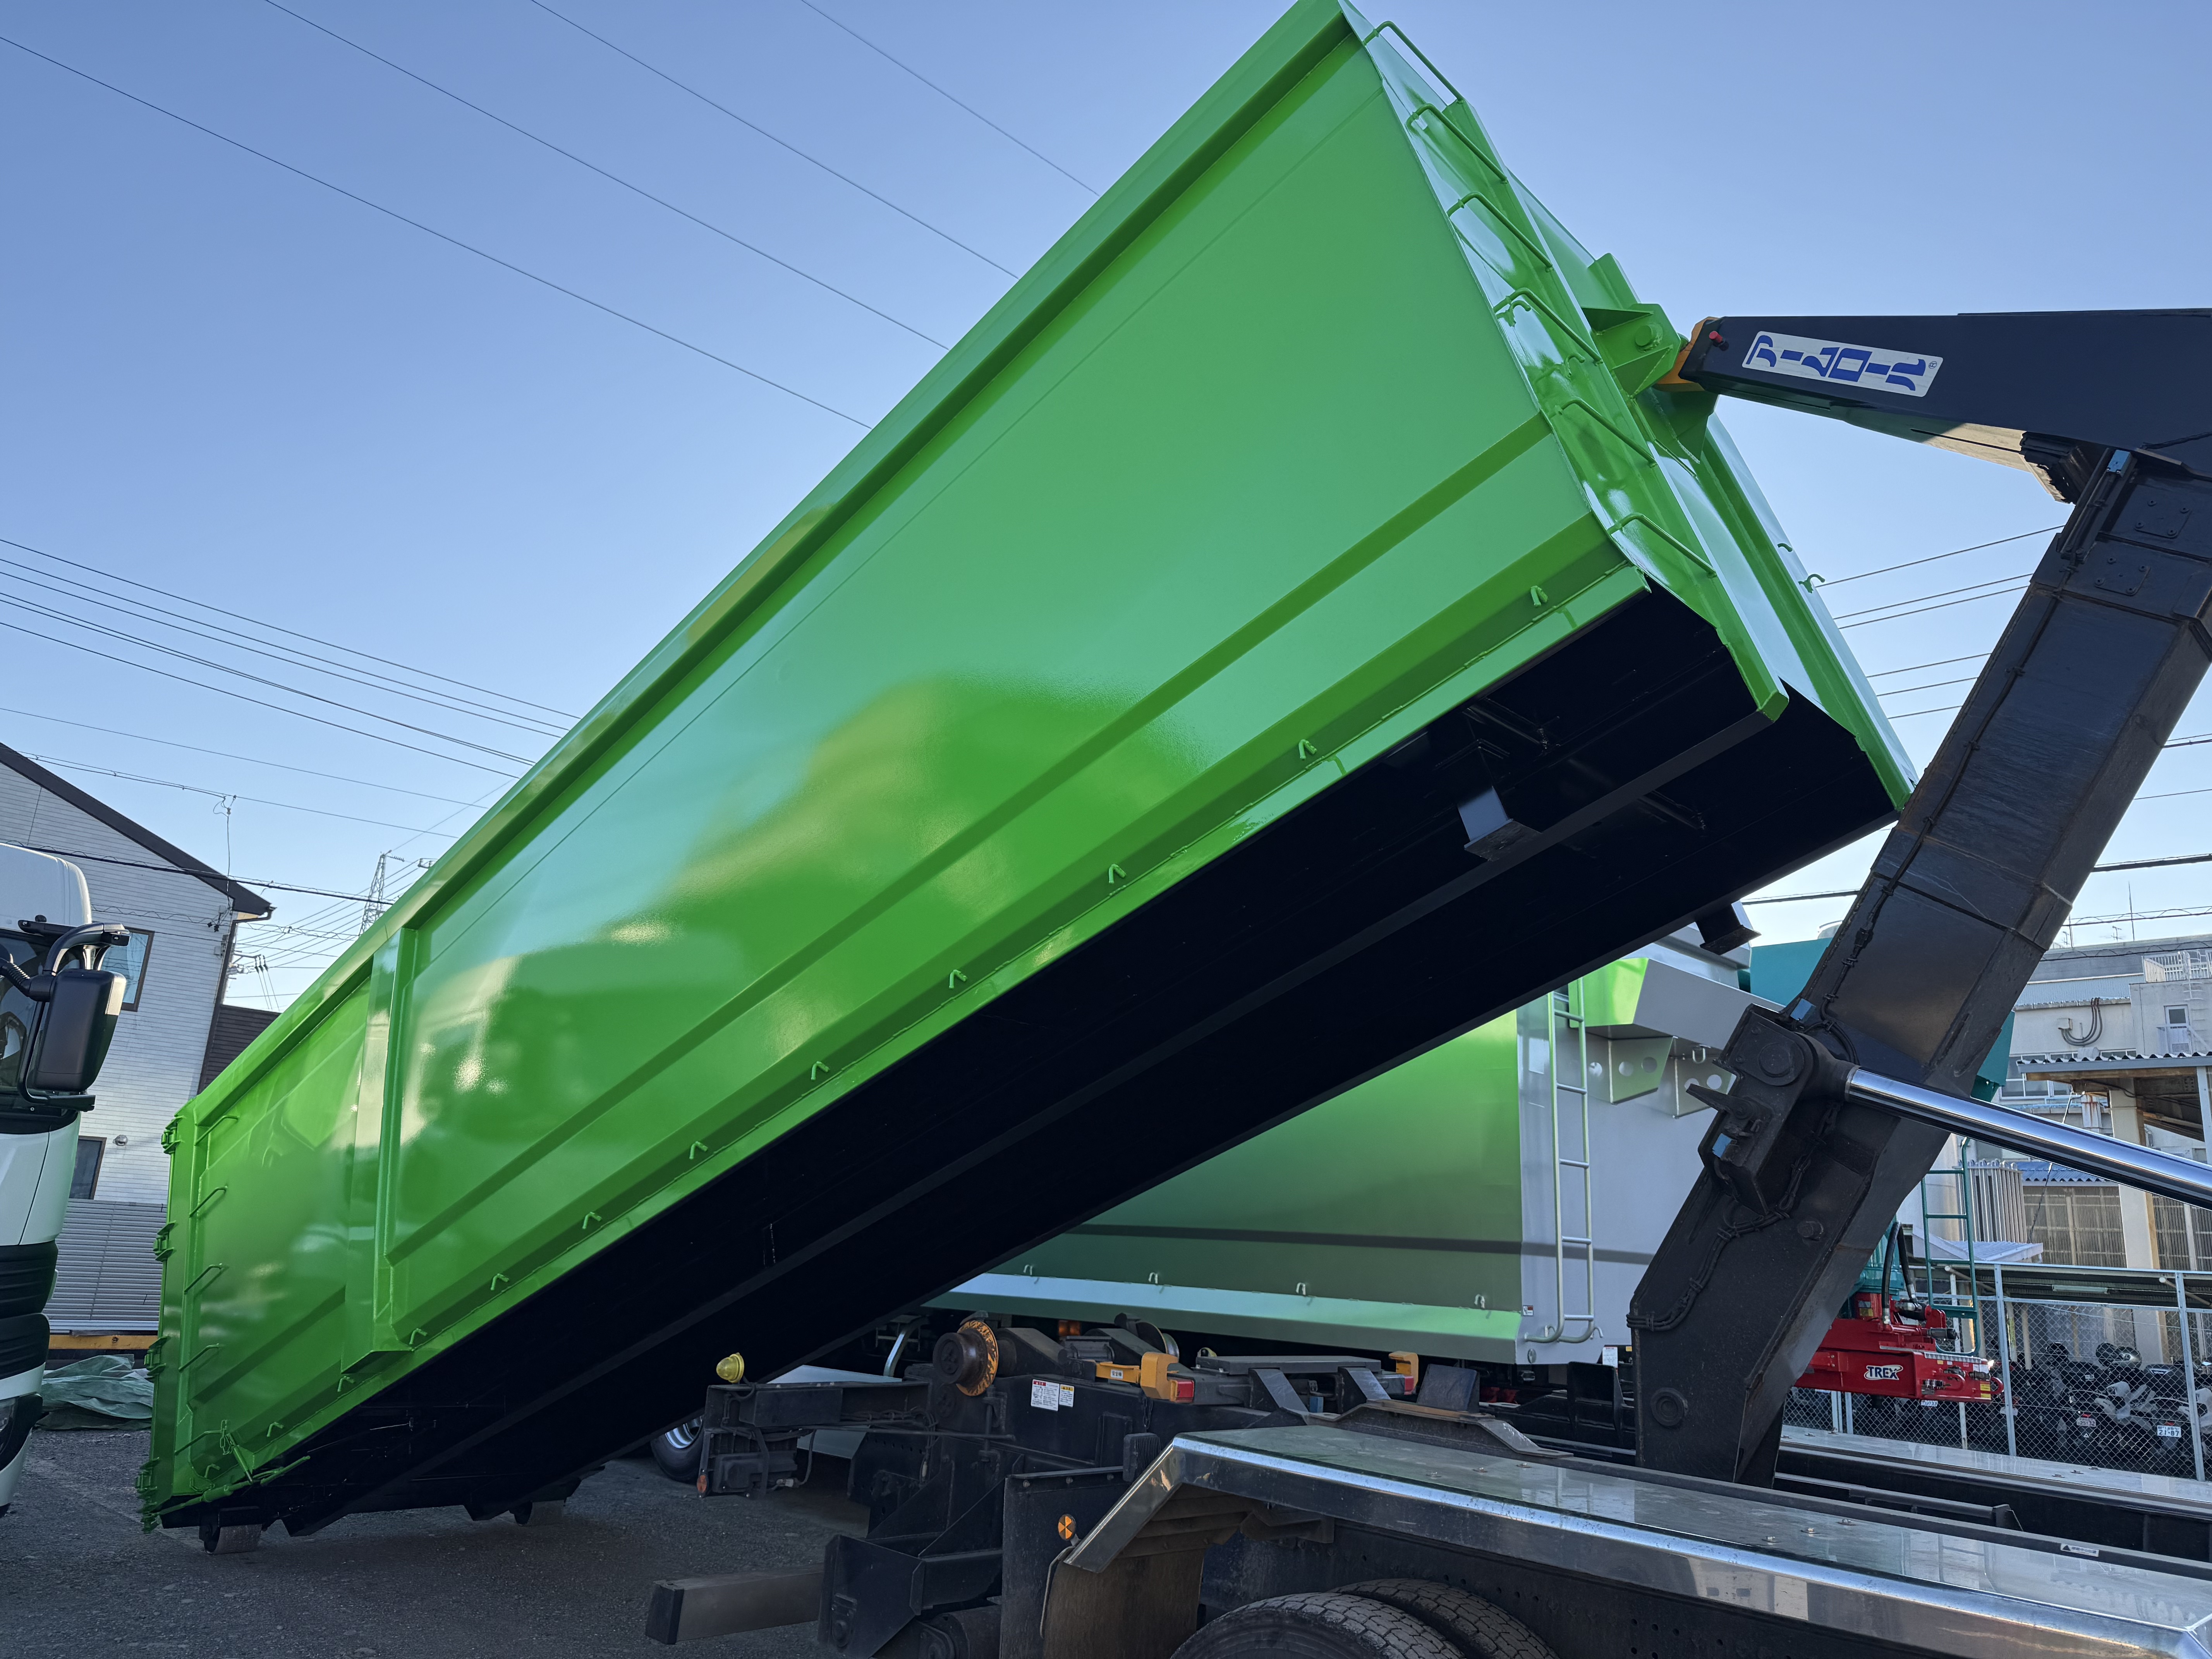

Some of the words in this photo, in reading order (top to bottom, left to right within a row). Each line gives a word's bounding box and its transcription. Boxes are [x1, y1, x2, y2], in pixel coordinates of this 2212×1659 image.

[1746, 335, 1926, 391] アームロール
[1867, 1366, 1898, 1379] TREX
